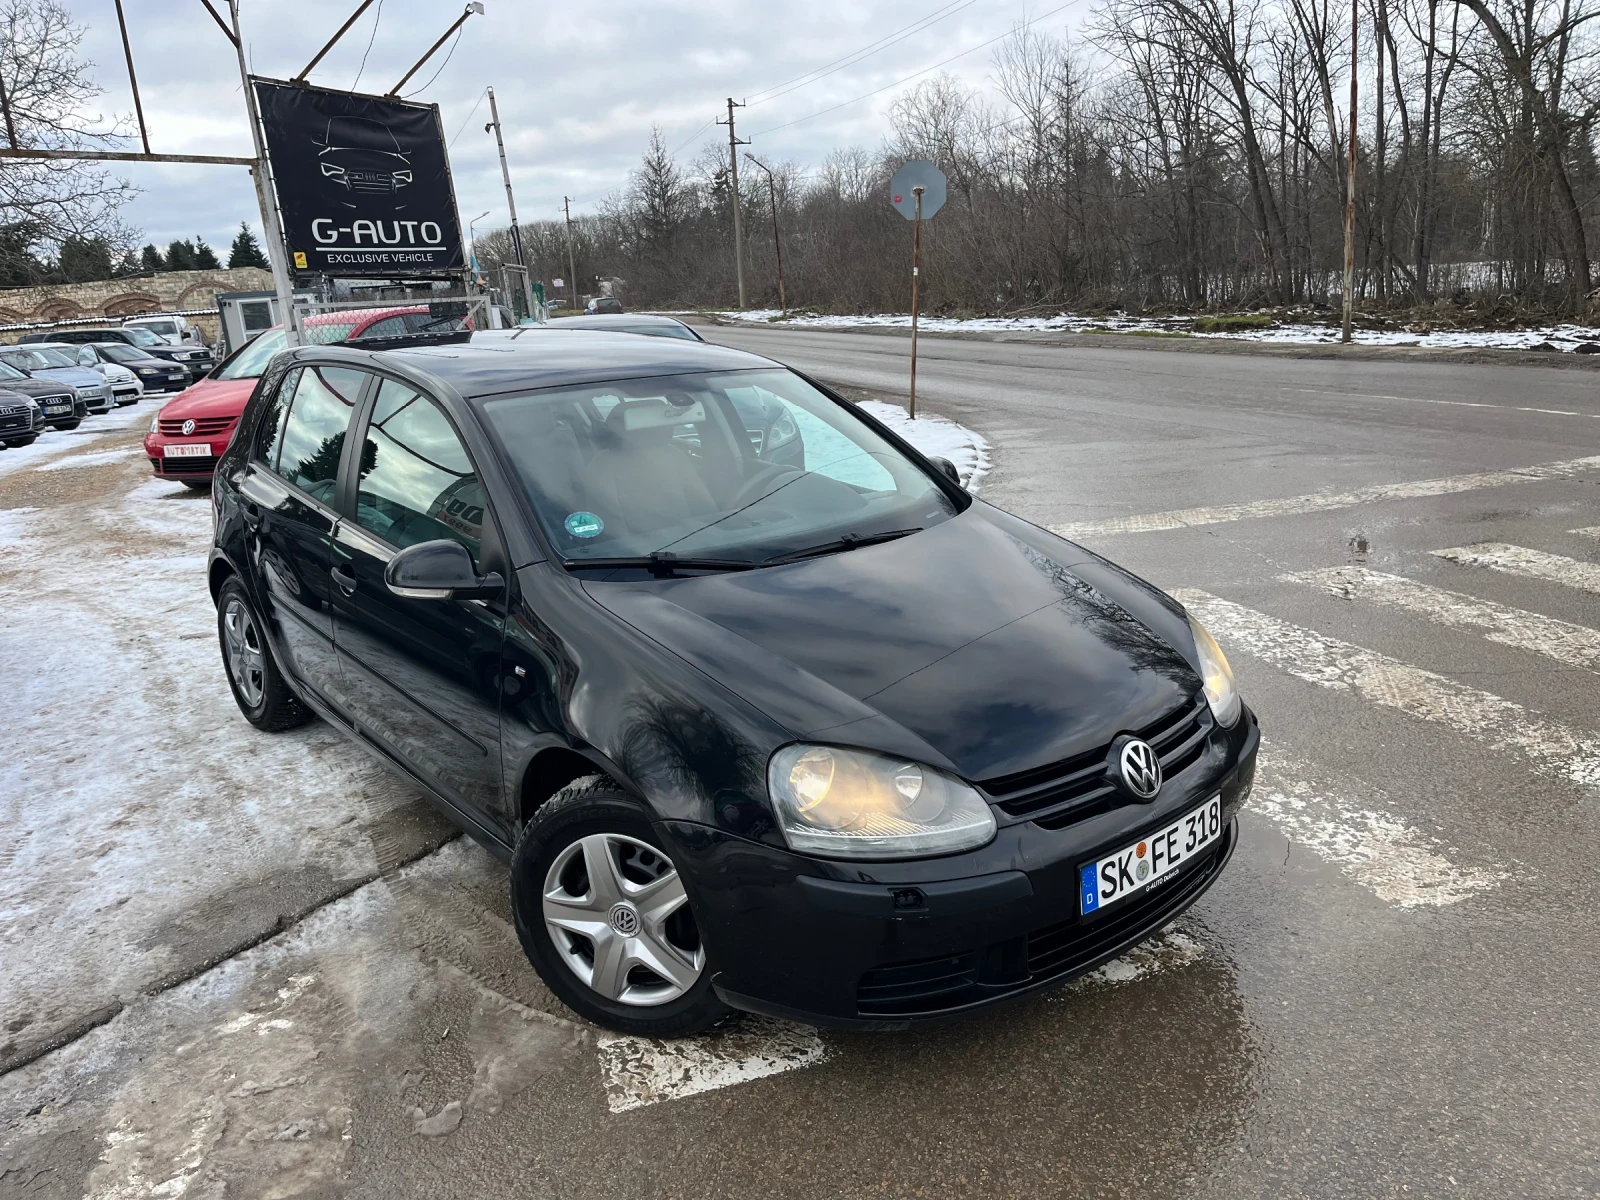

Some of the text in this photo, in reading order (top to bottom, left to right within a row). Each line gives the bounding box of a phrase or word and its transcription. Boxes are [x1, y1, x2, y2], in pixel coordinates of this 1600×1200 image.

[311, 218, 442, 244] G-AUTO
[327, 253, 434, 264] EXCLUSIVE VEHICLE
[1086, 801, 1219, 905] D SK FE 318
[1145, 877, 1163, 892] G-AUTO
